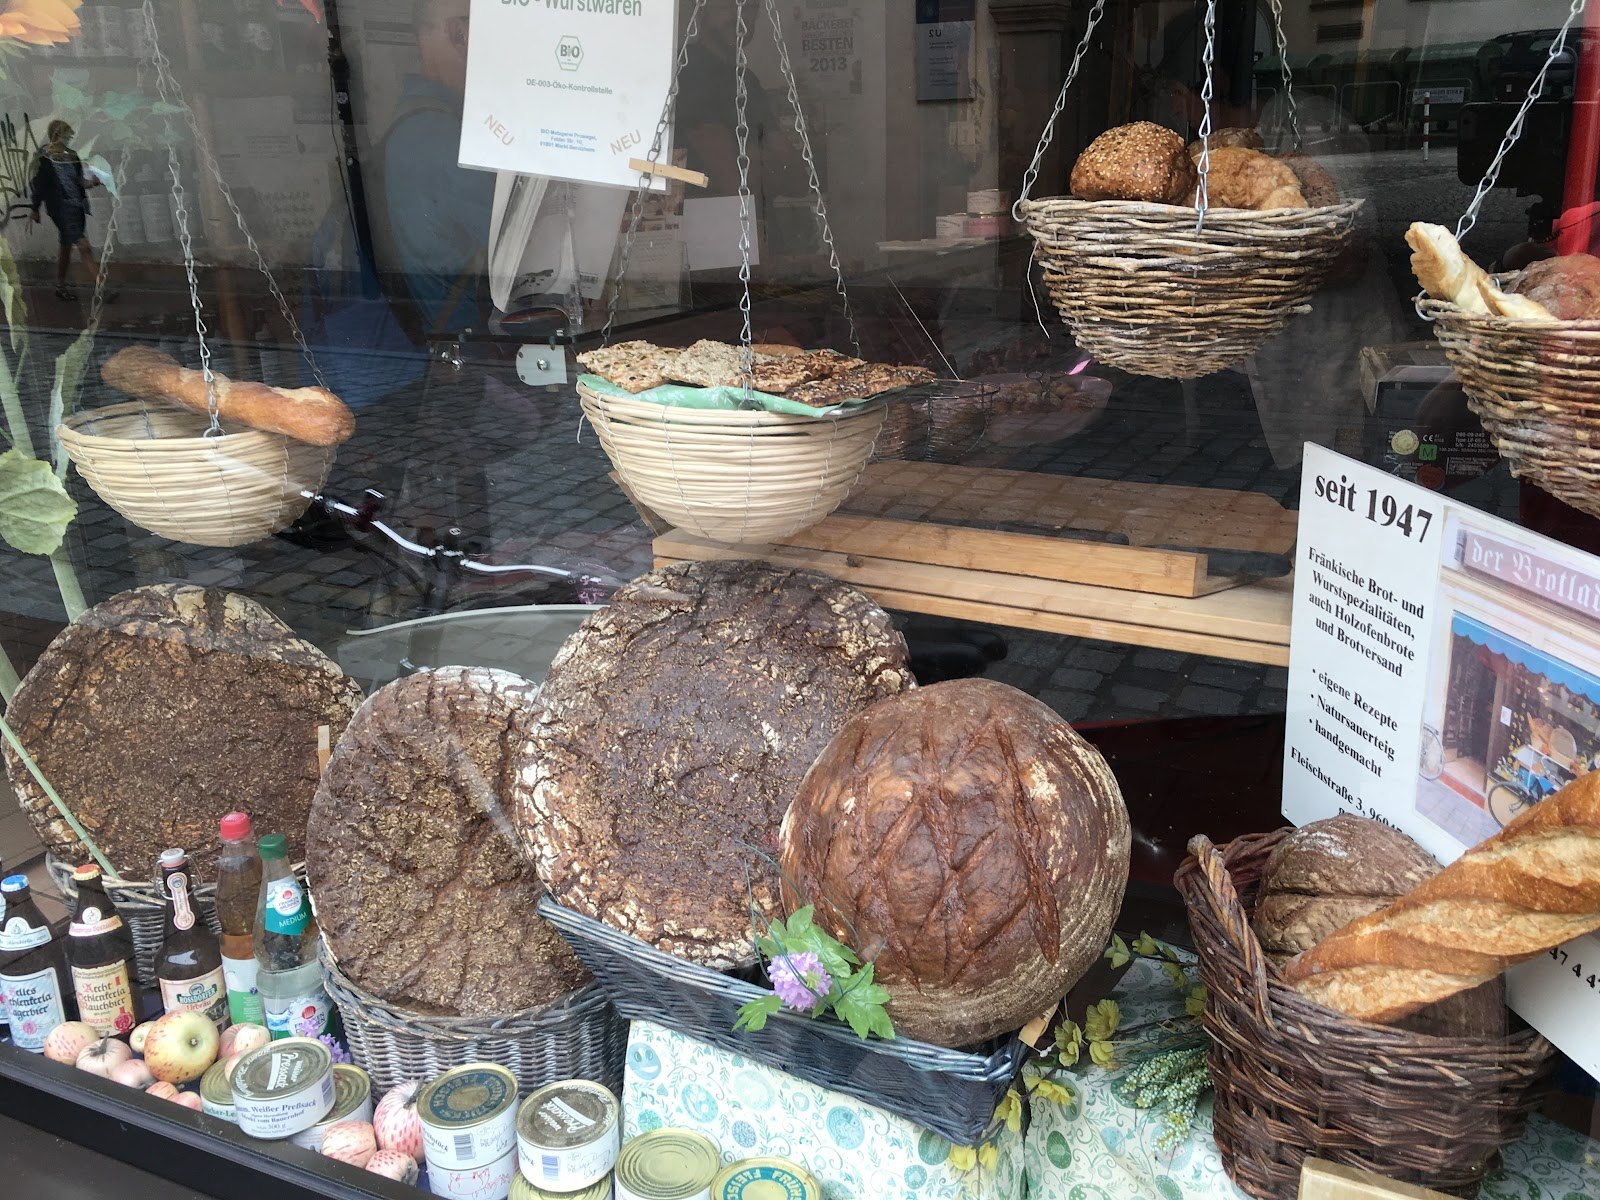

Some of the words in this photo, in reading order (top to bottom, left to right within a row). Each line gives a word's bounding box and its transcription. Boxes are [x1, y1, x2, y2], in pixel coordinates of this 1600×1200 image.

[802, 36, 854, 51] BESTEN
[809, 57, 848, 72] 2013
[484, 114, 515, 146] NEU
[609, 129, 642, 155] NEU
[1315, 474, 1357, 513] seit
[1365, 489, 1433, 544] 1947
[1471, 537, 1504, 572] der
[1308, 547, 1365, 588] Fränkische
[1368, 577, 1398, 604] Brot-
[1402, 595, 1424, 620] und
[1312, 569, 1415, 641] Wurstspezialitäten,
[1308, 591, 1333, 615] auch
[1335, 604, 1415, 662] Holzofenbrote
[1315, 617, 1334, 636] und
[1336, 627, 1403, 677] Brotversand
[1318, 672, 1351, 701] eigene
[1354, 690, 1398, 732] Rezepte
[1315, 718, 1382, 777] handgemacht
[1317, 694, 1395, 761] Natursauerteig
[1290, 746, 1354, 804] Fleischstraße
[1356, 797, 1366, 816] 3,
[278, 911, 307, 928] MEDIUM
[79, 997, 126, 1011] Rauchbier
[251, 1105, 279, 1113] Weißer
[771, 1169, 804, 1200] FRÜH
